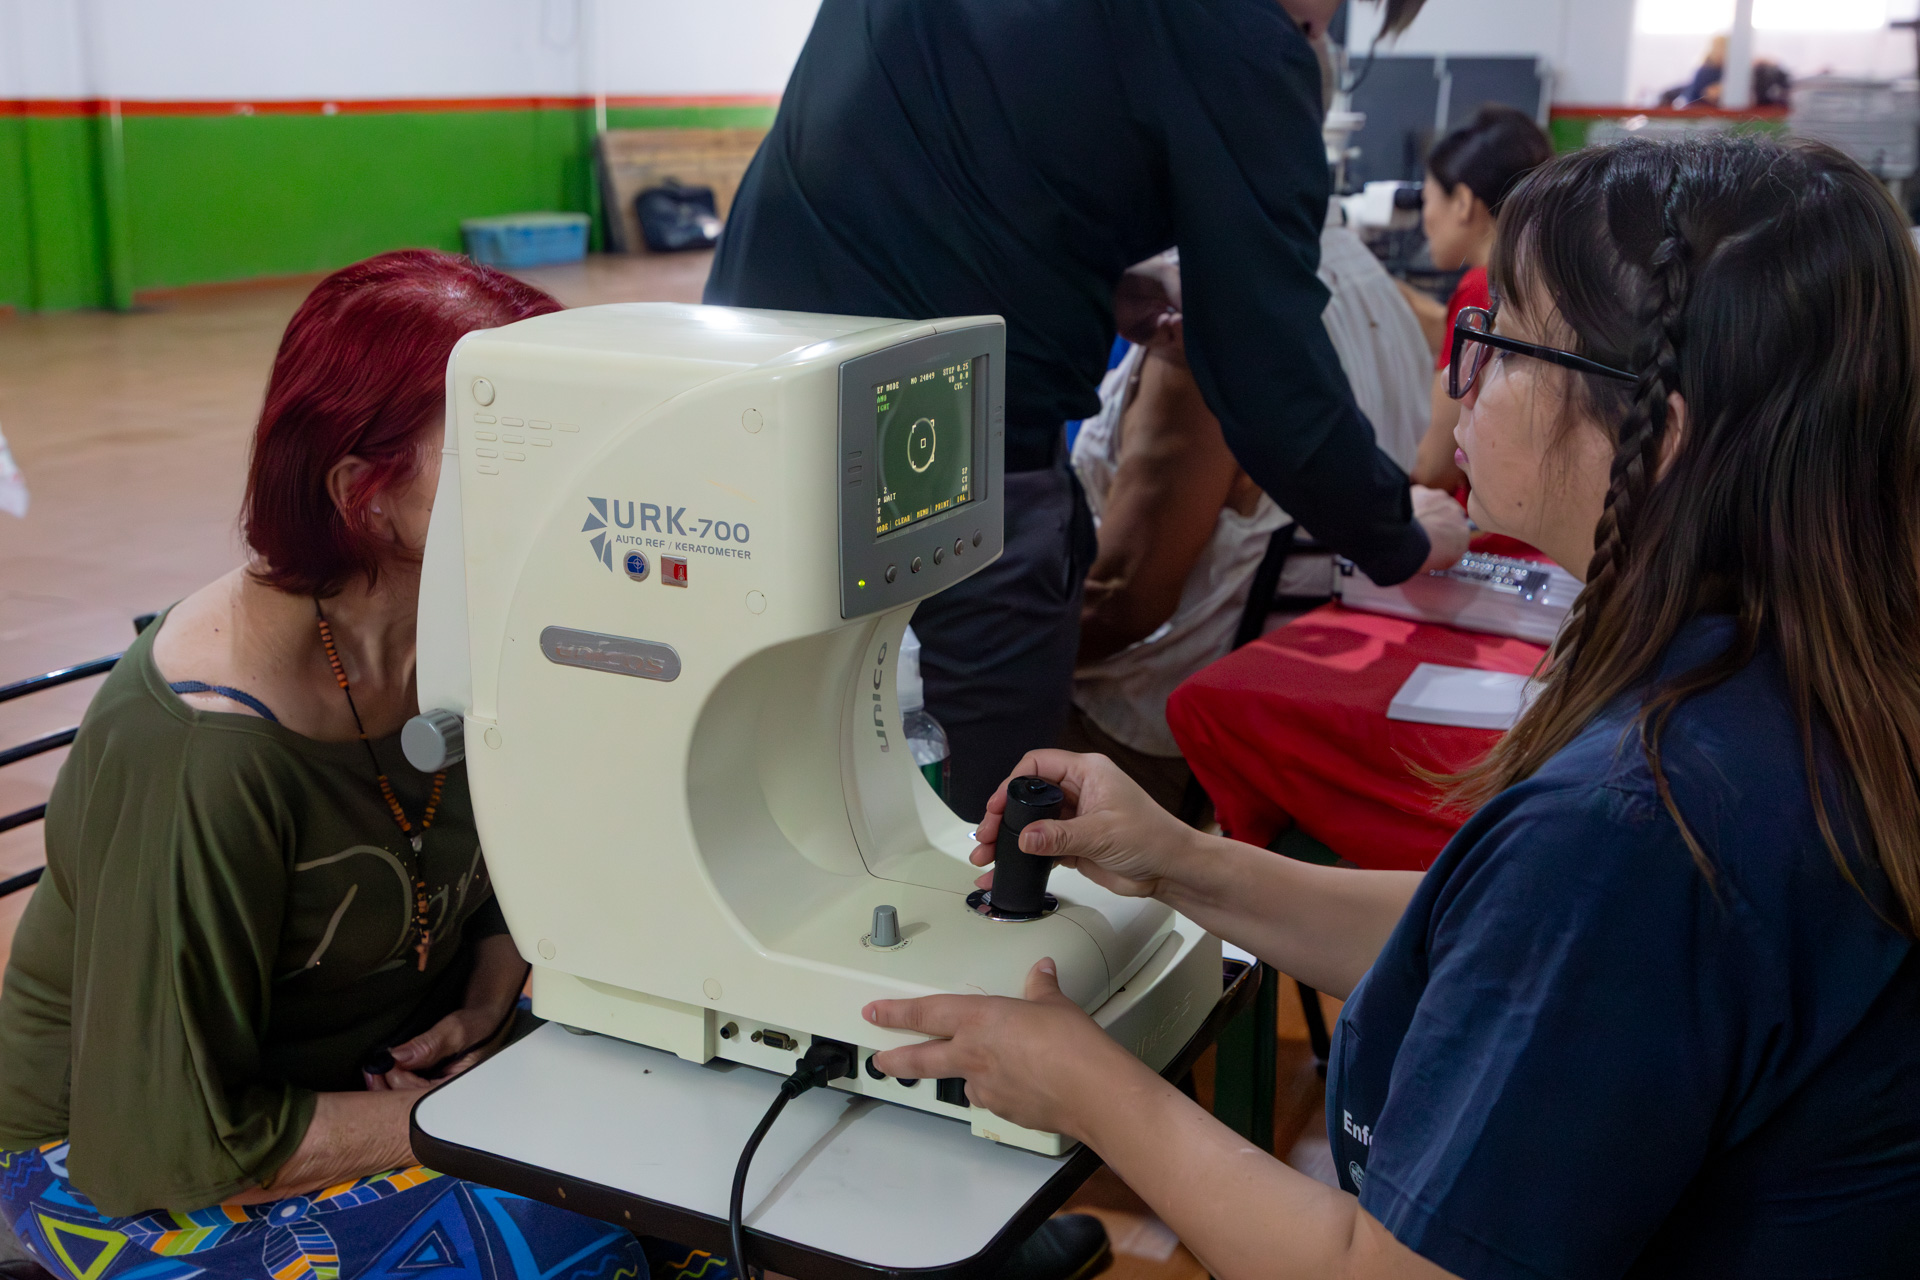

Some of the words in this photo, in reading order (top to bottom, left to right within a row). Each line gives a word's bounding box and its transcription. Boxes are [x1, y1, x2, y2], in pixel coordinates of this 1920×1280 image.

[942, 366, 955, 376] STEP
[956, 362, 969, 372] 0.25
[886, 381, 900, 392] MODE
[953, 382, 964, 391] CYL
[613, 499, 750, 544] URK-700
[894, 514, 911, 527] CLEAR
[916, 508, 929, 518] MENU
[934, 500, 950, 511] PRINT
[615, 534, 642, 546] AUTO
[645, 538, 665, 548] REF
[675, 542, 751, 560] KERATOMETER
